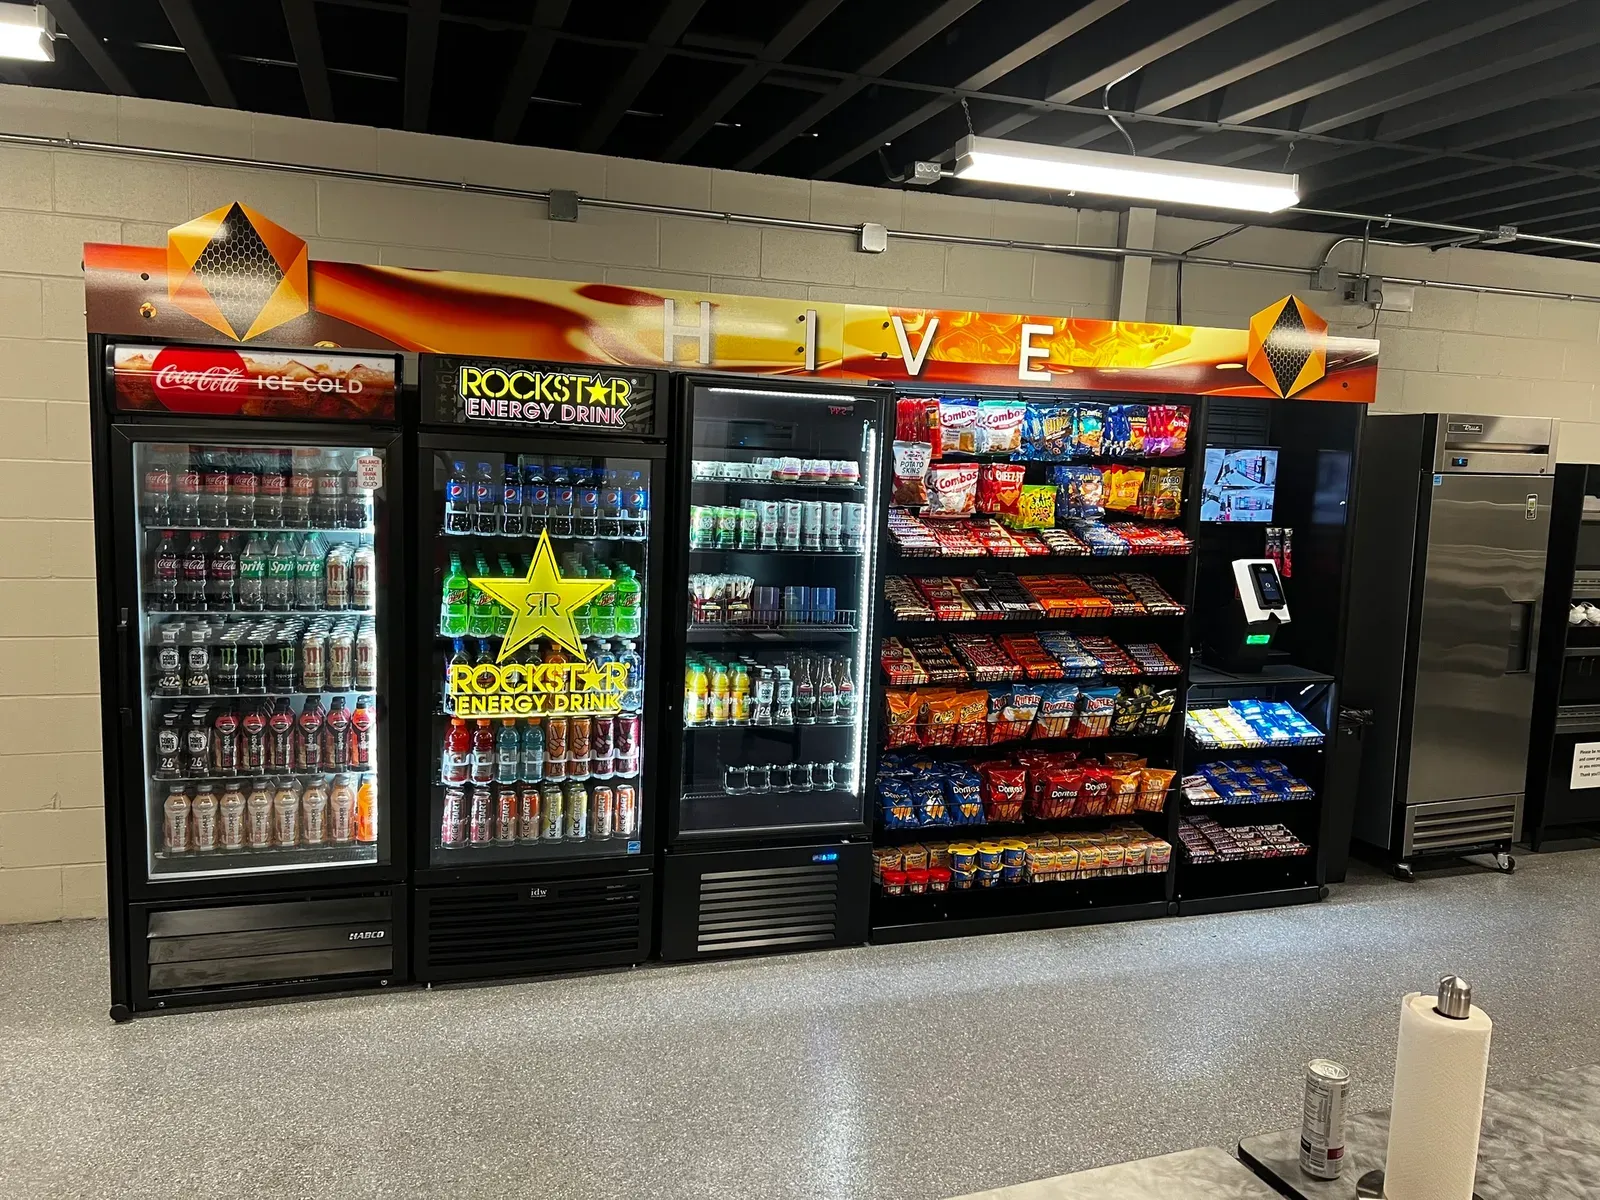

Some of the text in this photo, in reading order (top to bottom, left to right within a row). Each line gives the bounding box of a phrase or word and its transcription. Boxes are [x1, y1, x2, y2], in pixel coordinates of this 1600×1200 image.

[663, 298, 1055, 383] HIVE
[257, 374, 363, 394] ICE COLD
[468, 397, 625, 425] ENERGY DRINK
[942, 408, 977, 423] Combos
[987, 408, 1025, 424] Combos
[900, 460, 924, 468] POTATO
[938, 469, 978, 490] Combos
[458, 693, 620, 714] ENERGY DRINK
[1042, 700, 1076, 713] RUFFLES
[161, 757, 174, 768] 26
[191, 756, 203, 767] 26
[953, 784, 980, 795] Doritos
[1051, 790, 1078, 798] Doritos
[530, 887, 548, 896] idw
[349, 930, 385, 940] HABCO
